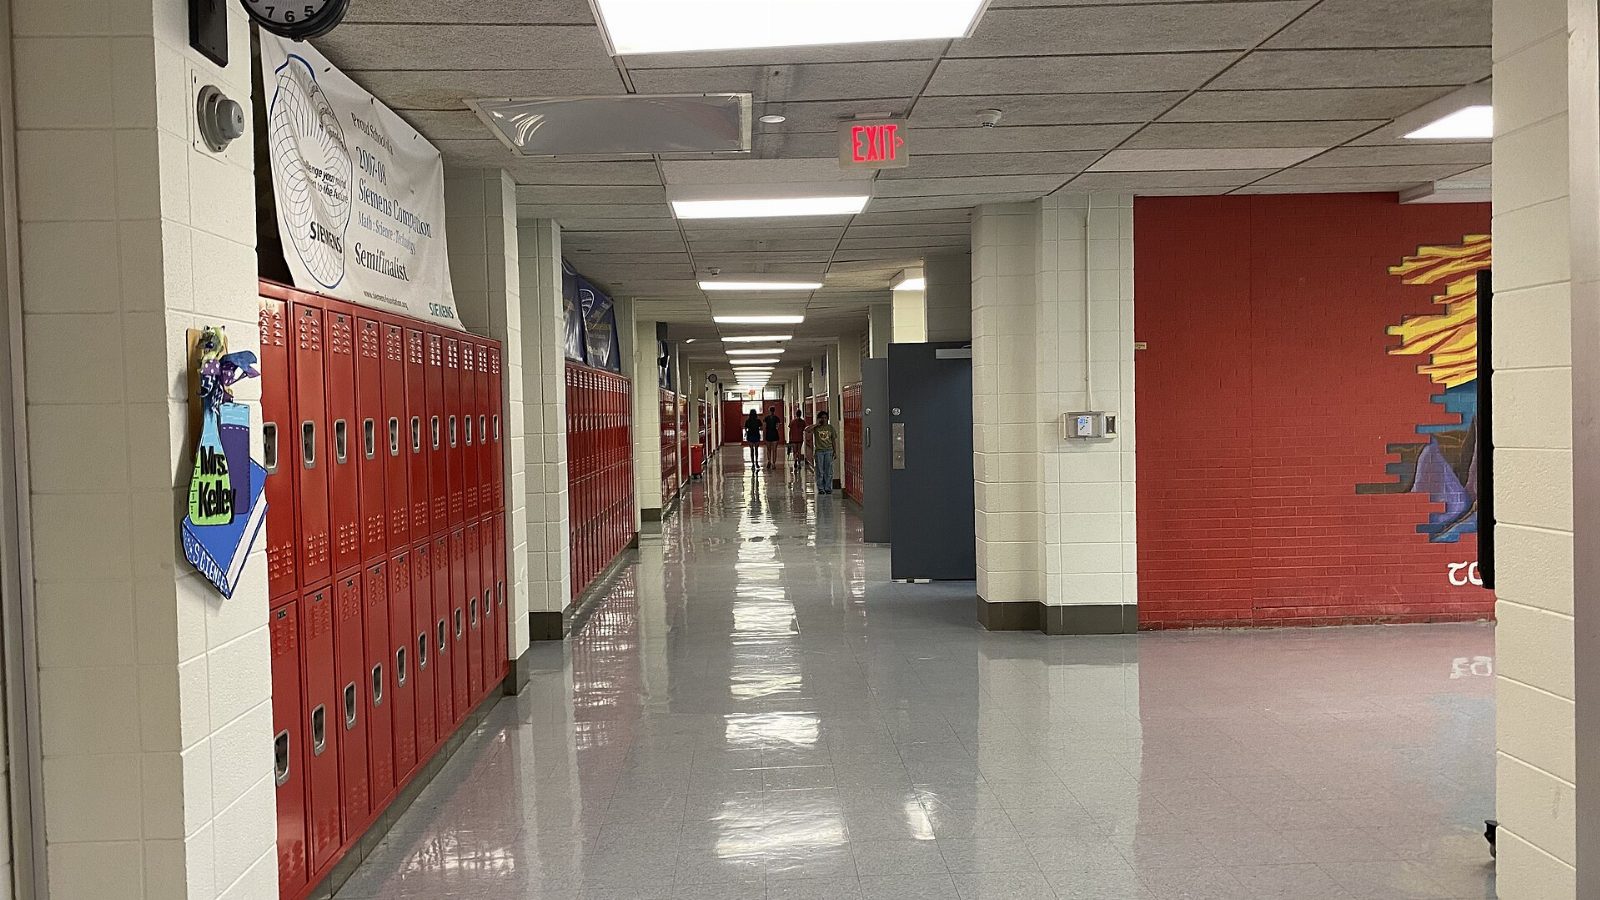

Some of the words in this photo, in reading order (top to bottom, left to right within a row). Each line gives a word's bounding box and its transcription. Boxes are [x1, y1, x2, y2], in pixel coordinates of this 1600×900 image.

[265, 6, 275, 18] 7
[284, 10, 295, 23] 6
[304, 5, 315, 17] 5
[851, 124, 898, 163] EXIT
[356, 146, 387, 186] 2007-08
[359, 178, 392, 217] Siemens
[310, 221, 342, 254] SIEMENS
[358, 211, 373, 231] Math
[355, 242, 410, 282] Semifinalist
[429, 302, 454, 319] SIEMENS
[198, 479, 236, 519] Kelley
[193, 542, 226, 592] SCIENCE
